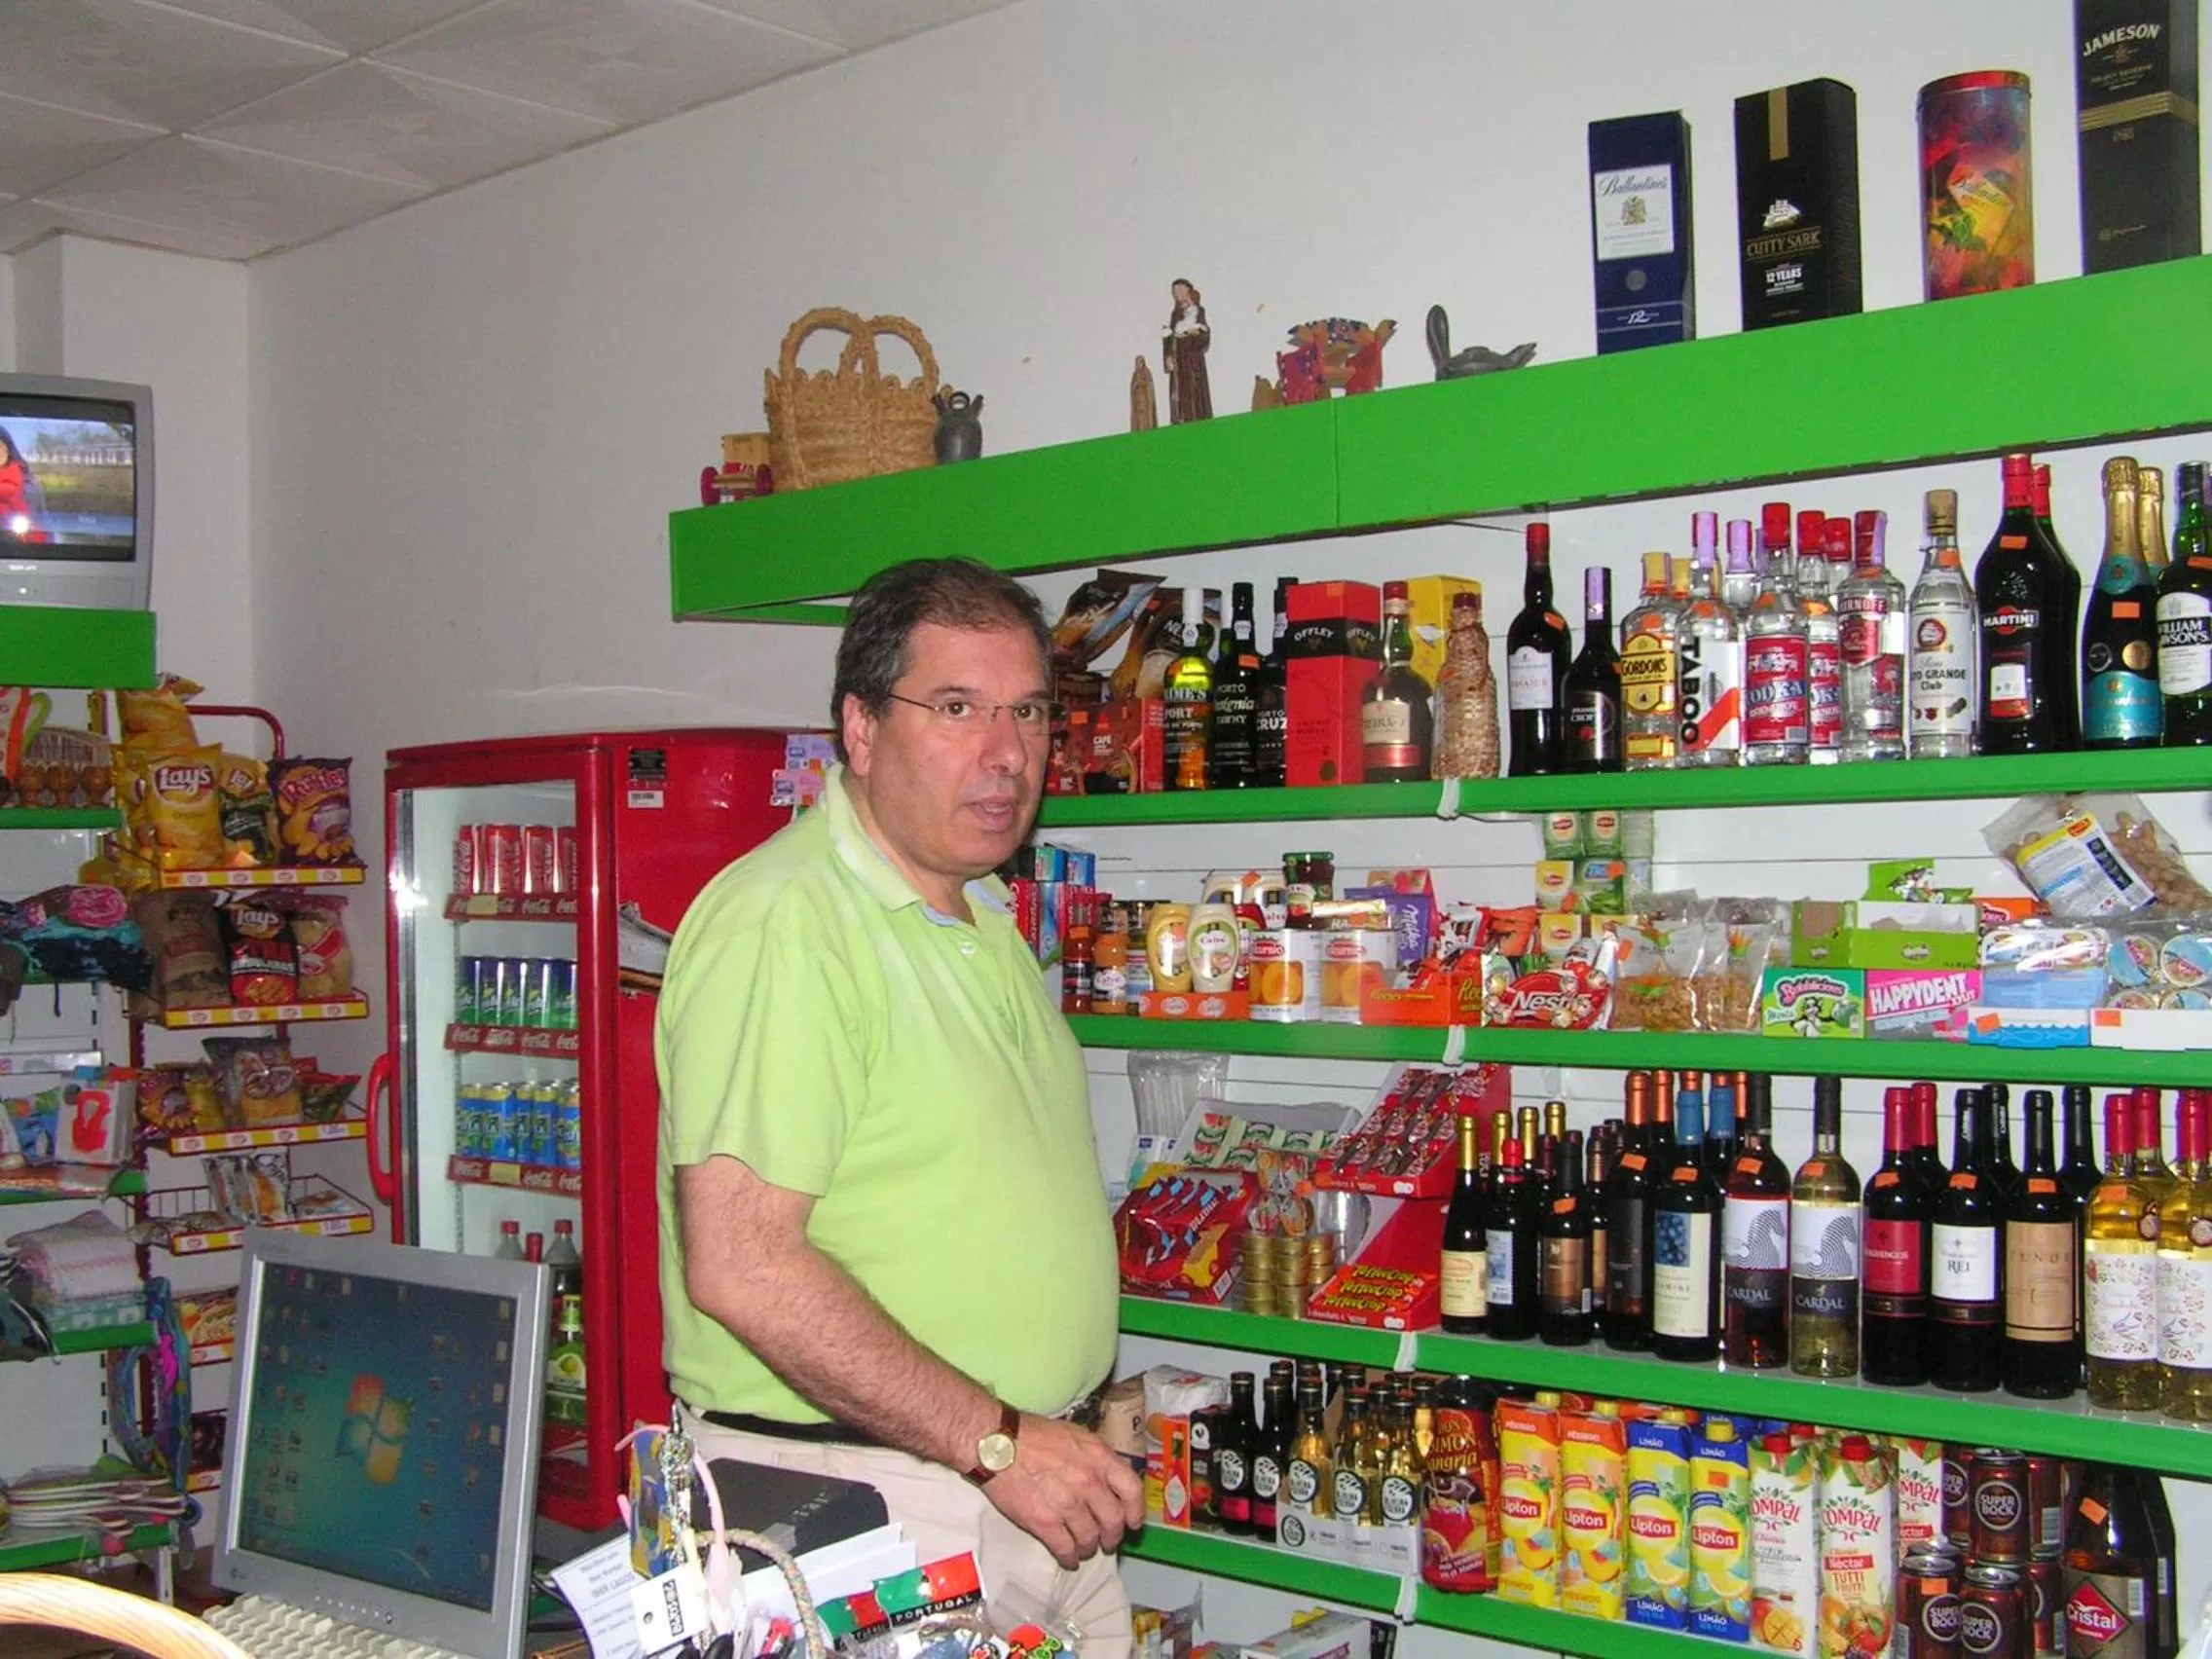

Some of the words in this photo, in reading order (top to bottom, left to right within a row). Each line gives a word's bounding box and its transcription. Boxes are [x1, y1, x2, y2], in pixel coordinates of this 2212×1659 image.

[2083, 23, 2160, 56] JAMESON
[1747, 237, 1788, 258] CUTTY
[1788, 229, 1821, 250] SARK
[1627, 310, 1651, 325] 12
[1840, 599, 1887, 611] IRNOFF
[1982, 613, 2036, 628] MARTINI
[1294, 626, 1335, 642] OFFLEY
[1925, 669, 1967, 680] GRANDE
[1680, 636, 1702, 745] TABOO
[1402, 903, 1420, 954] Milka
[1869, 973, 1967, 1014] HAPPYDENT
[1794, 1294, 1847, 1311] CARDAL
[1700, 1446, 1726, 1458] LIMÃO
[1980, 1493, 2015, 1506] SUPER
[1565, 1509, 1604, 1528] Lipton
[1980, 1503, 2015, 1517] BOCK
[1630, 1516, 1674, 1536] Lipton
[1691, 1527, 1736, 1547] Lipton
[895, 1594, 975, 1623] PORTUGAL
[1929, 1606, 1959, 1618] SUPE
[2066, 1602, 2117, 1630] Cristal
